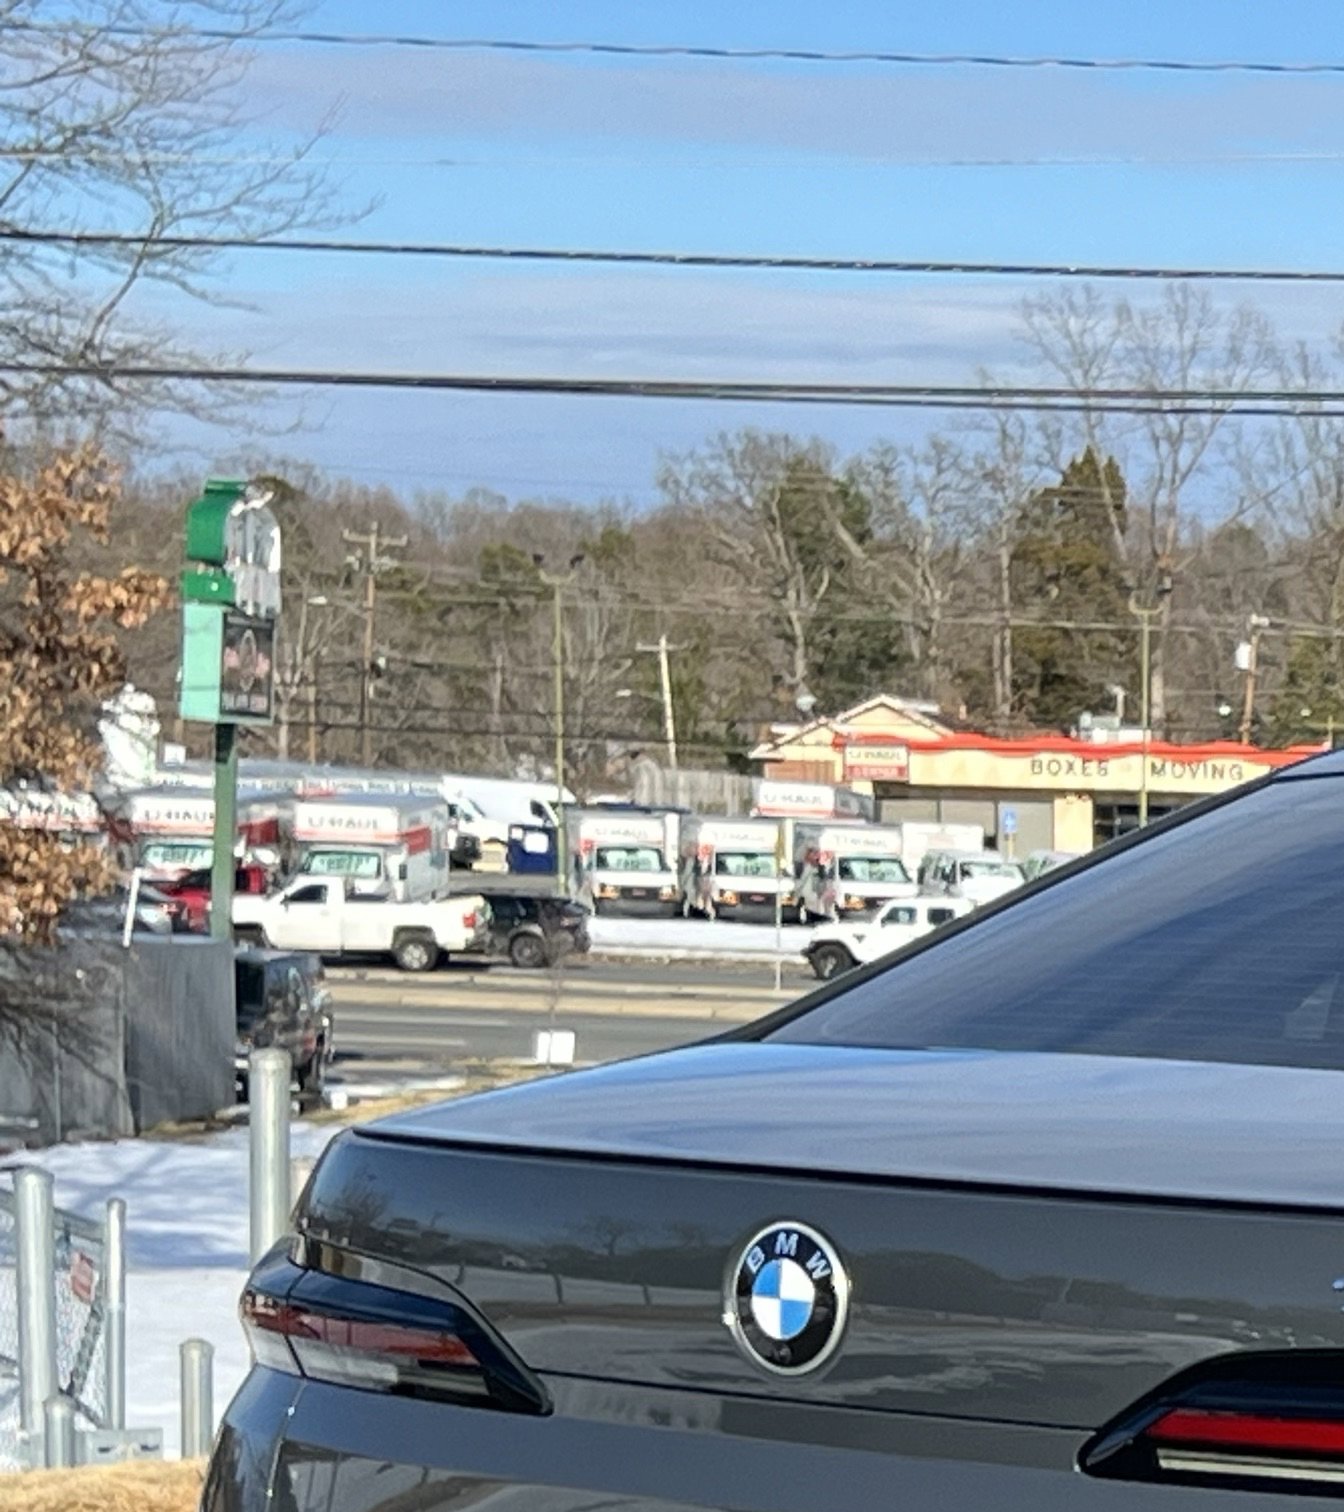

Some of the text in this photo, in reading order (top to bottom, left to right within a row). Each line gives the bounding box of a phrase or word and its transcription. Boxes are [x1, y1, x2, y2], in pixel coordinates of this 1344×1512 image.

[1031, 758, 1245, 780] BOXES MOVING
[745, 1231, 832, 1280] BMW
